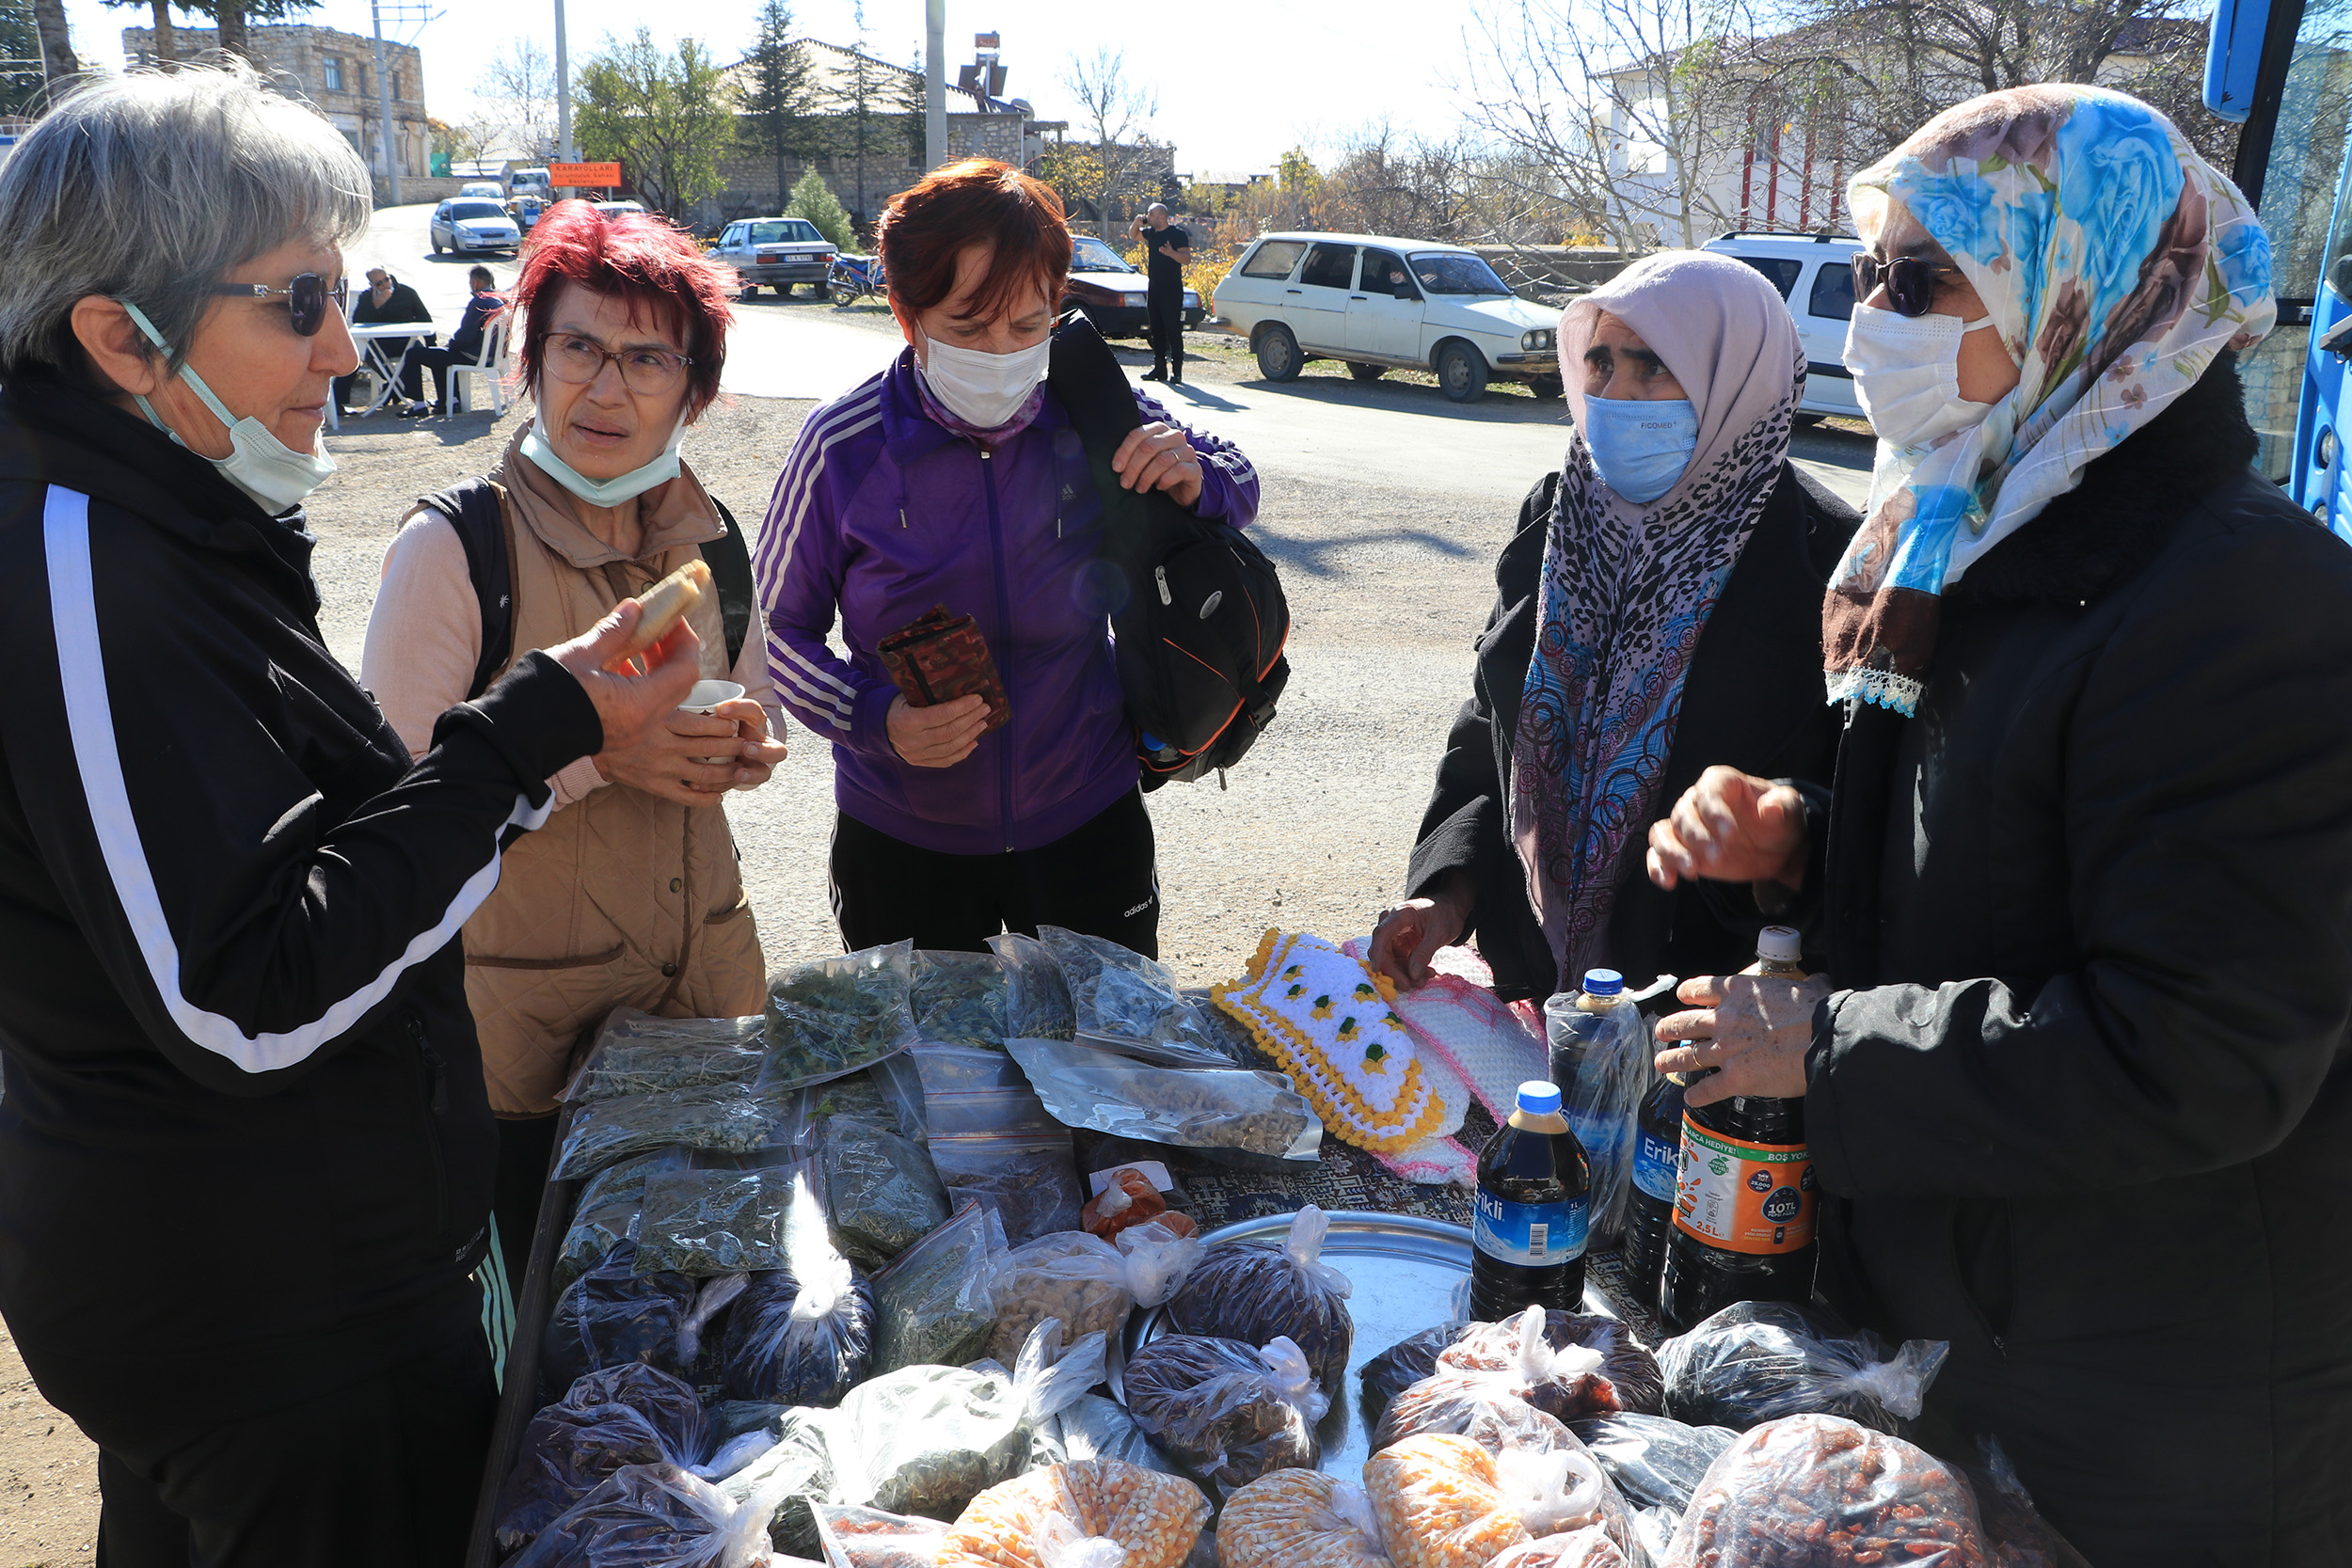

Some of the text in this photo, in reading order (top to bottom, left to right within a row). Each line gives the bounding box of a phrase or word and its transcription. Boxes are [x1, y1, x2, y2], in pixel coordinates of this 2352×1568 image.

[1124, 901, 1148, 917] adidas
[1645, 1136, 1678, 1167] Erik
[1705, 1138, 1737, 1154] HEDİYE!
[1768, 1153, 1788, 1162] BOŞ
[1476, 1191, 1502, 1221] rikli
[1696, 1221, 1719, 1237] 2,5 L
